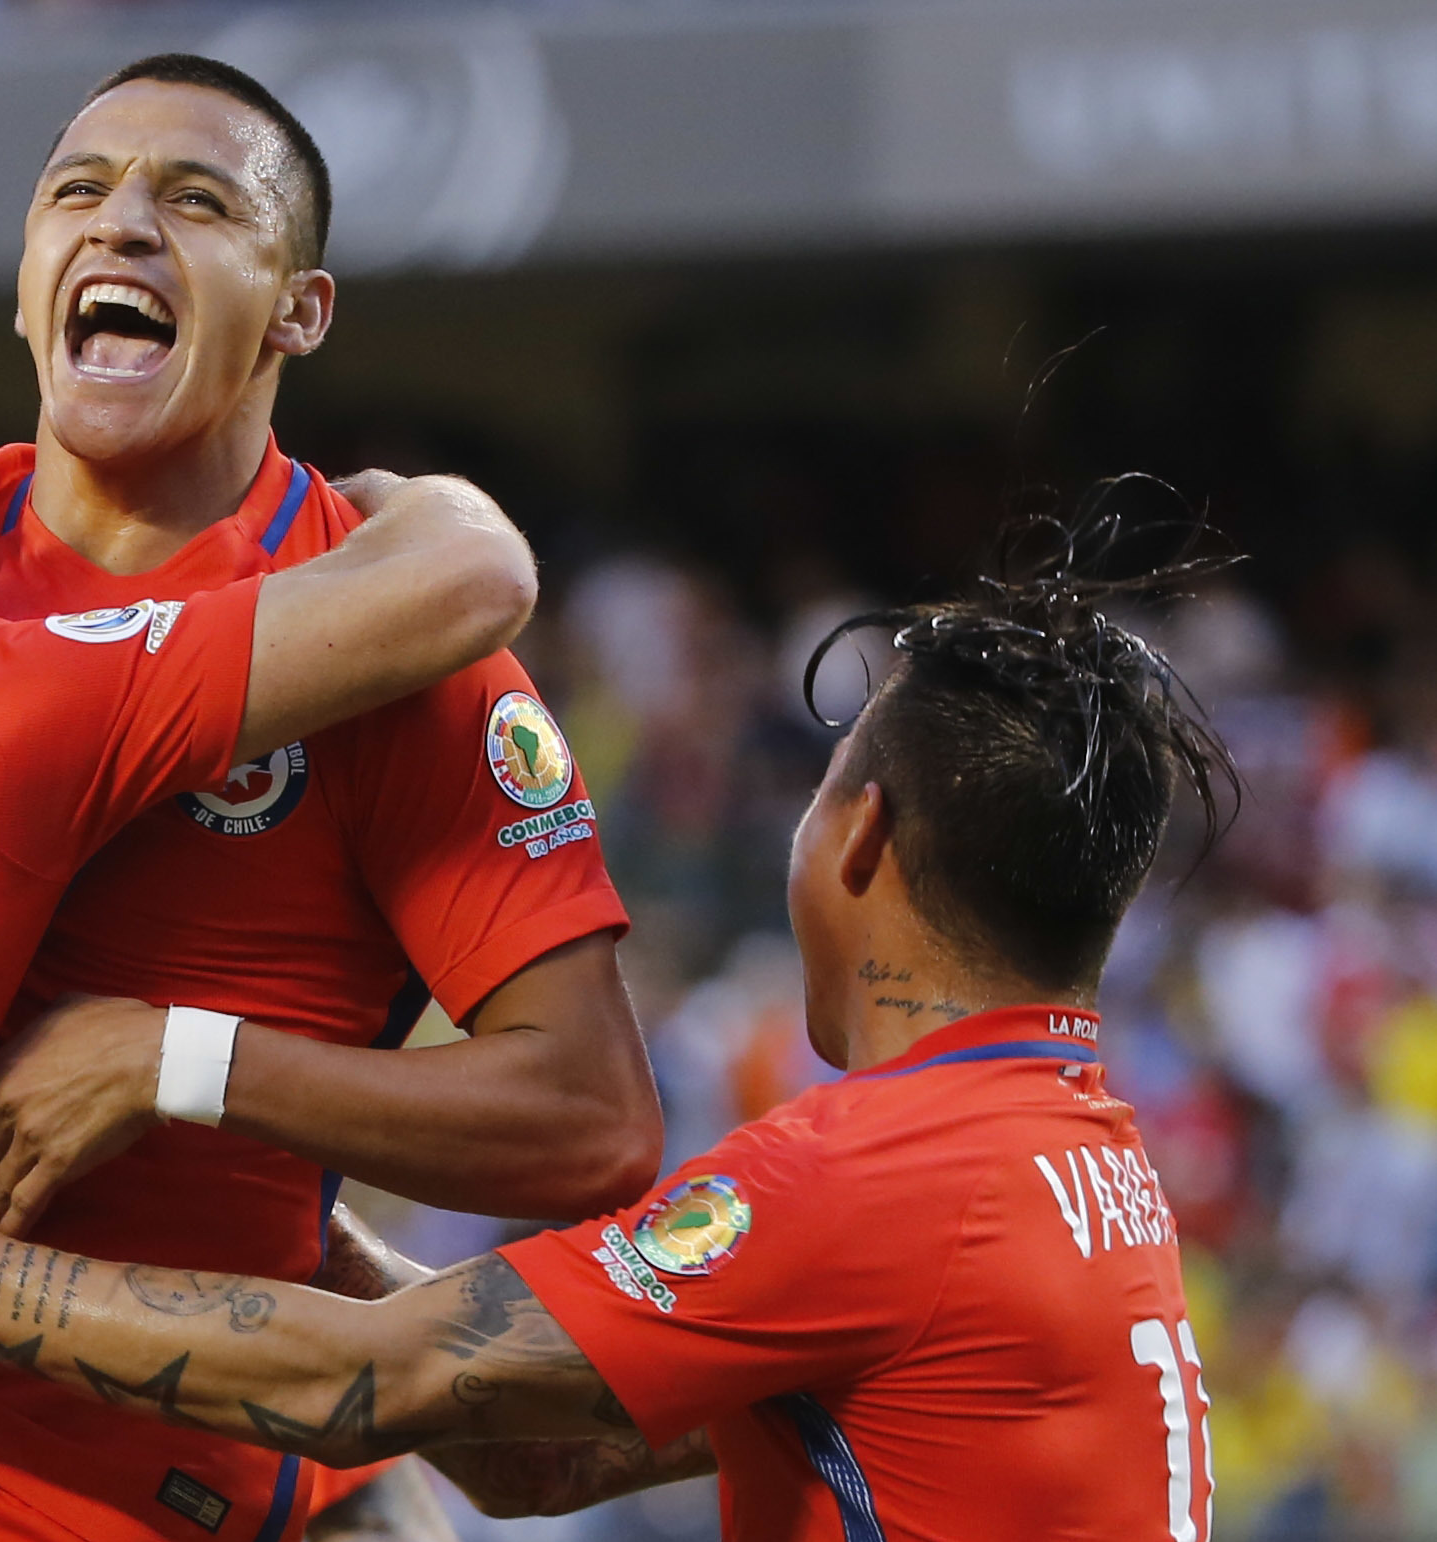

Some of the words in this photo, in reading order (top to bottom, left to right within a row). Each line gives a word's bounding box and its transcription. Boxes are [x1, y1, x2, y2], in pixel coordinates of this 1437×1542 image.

[195, 808, 216, 828] DE
[224, 815, 266, 834] CHILE
[528, 841, 547, 856] 100
[1049, 1013, 1069, 1035] LA
[1033, 1145, 1180, 1259] VARGA
[604, 1226, 675, 1311] CONMEBOL
